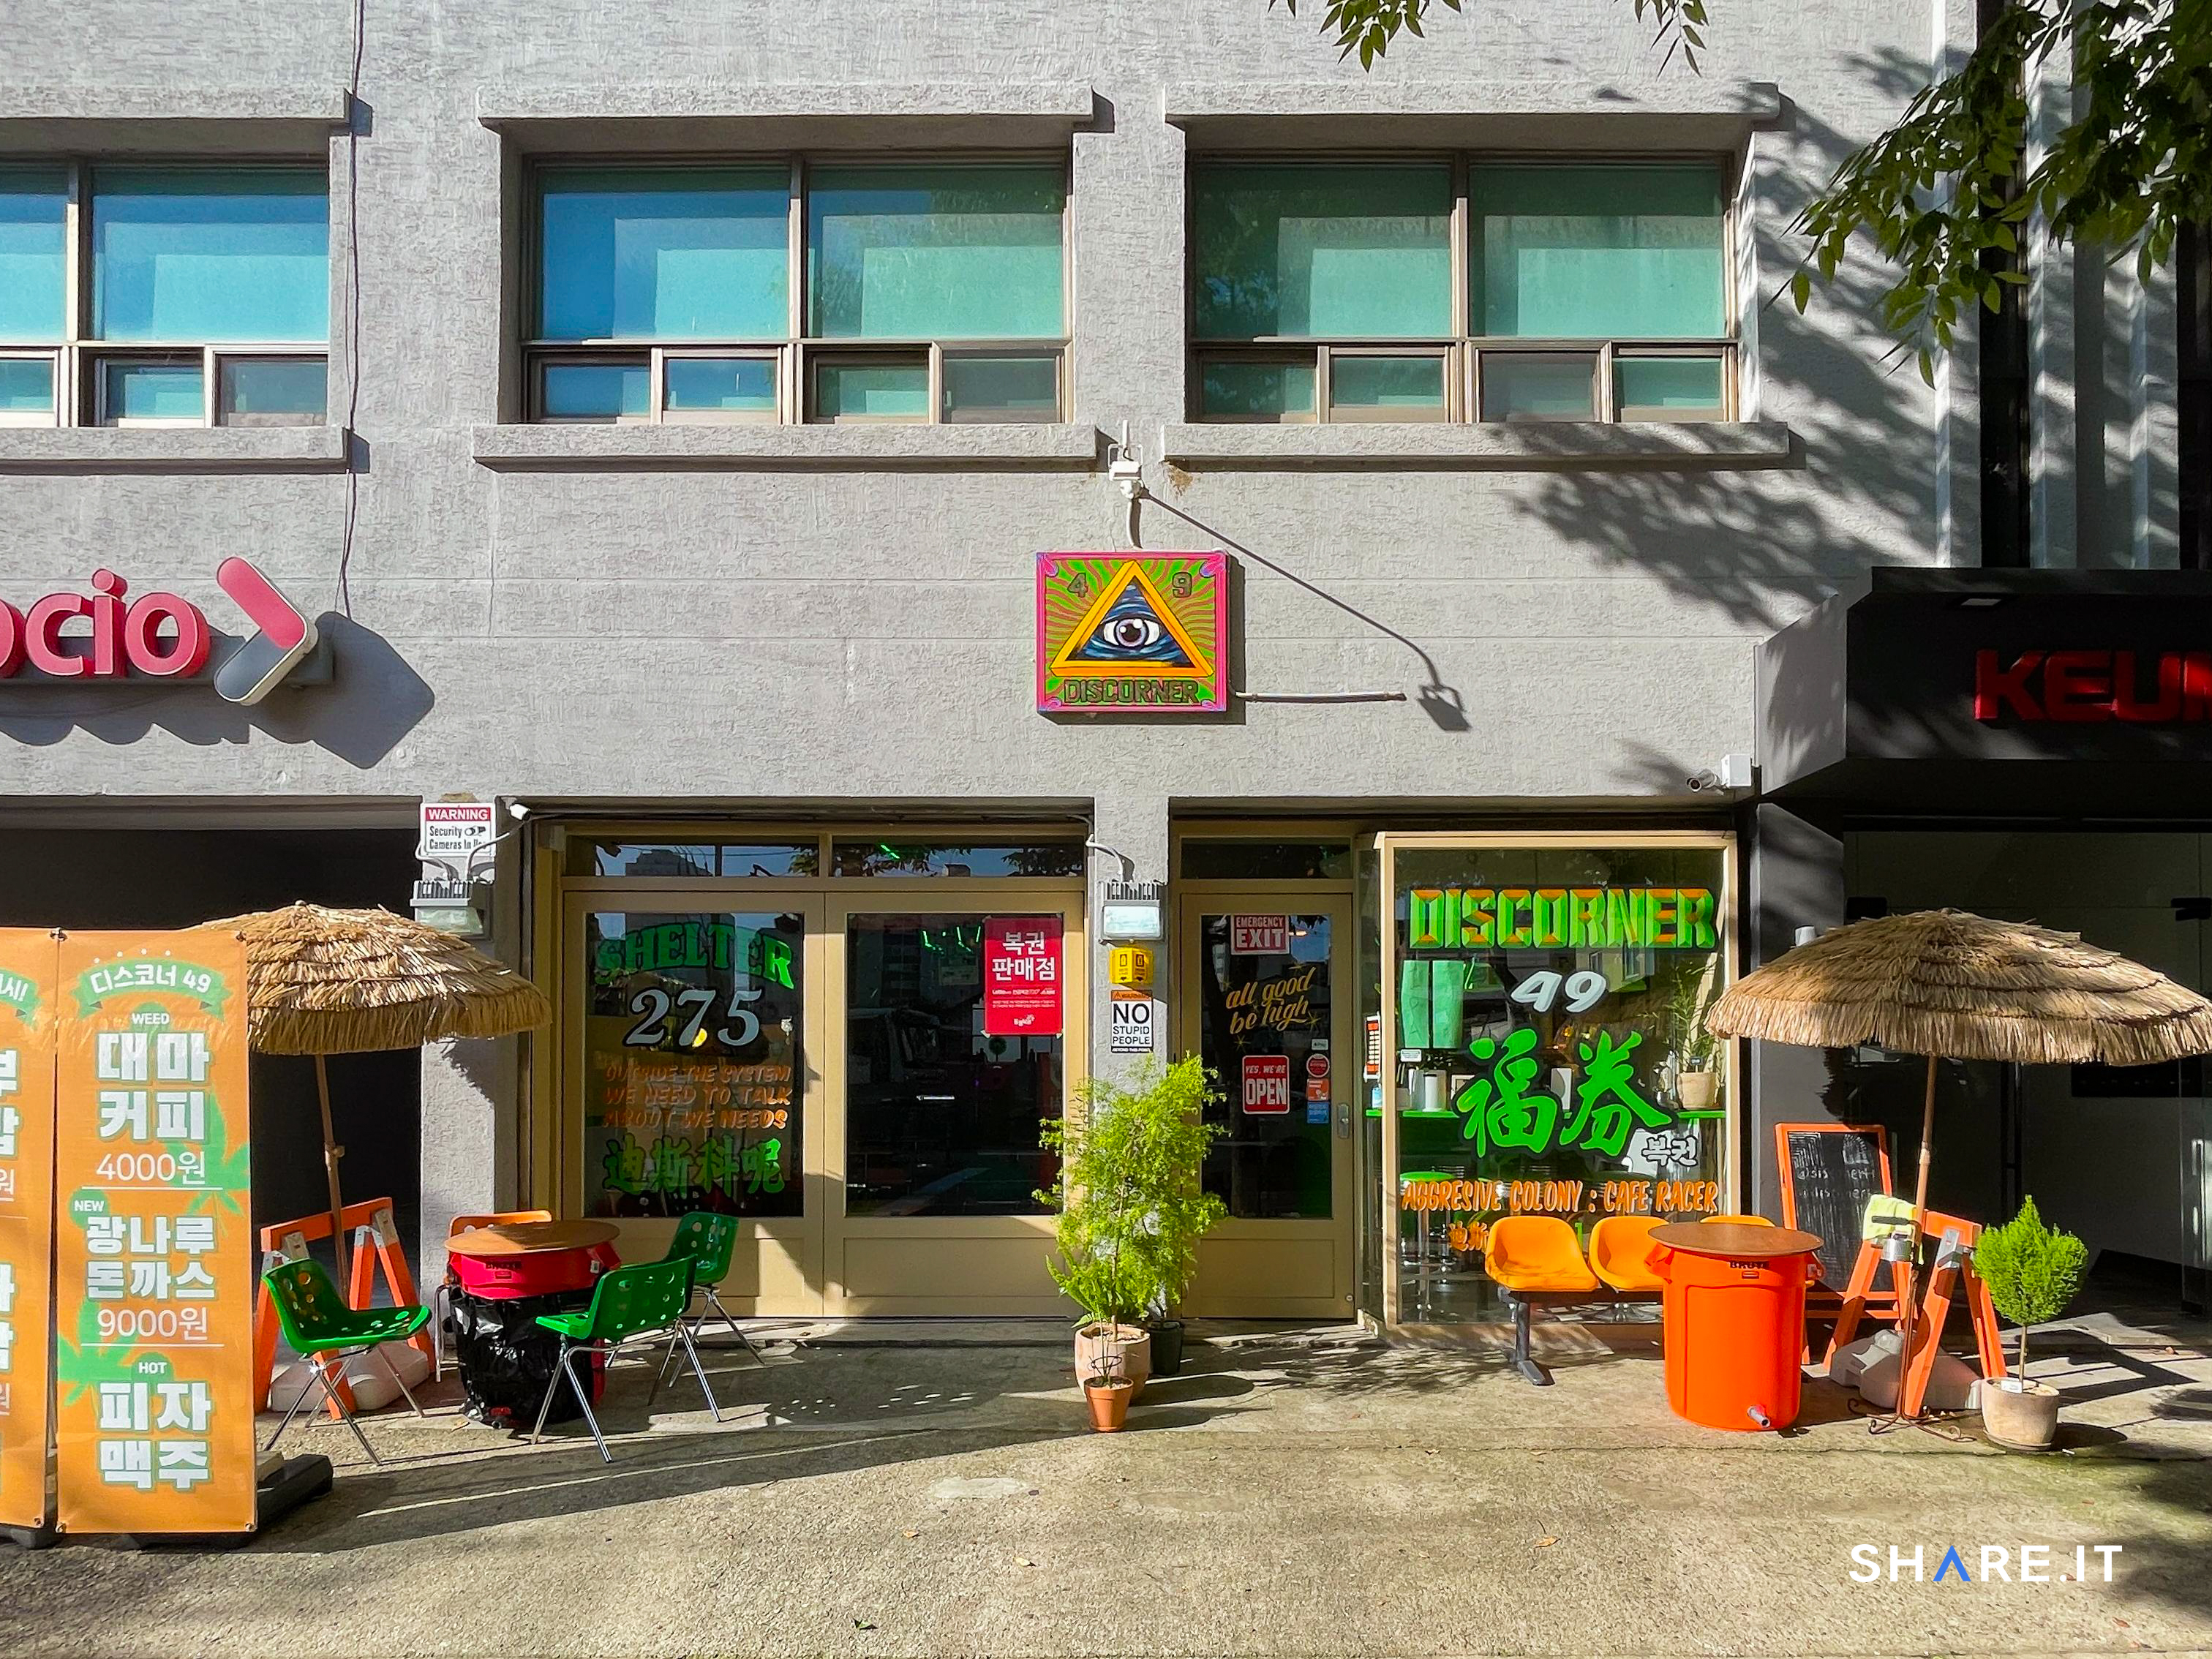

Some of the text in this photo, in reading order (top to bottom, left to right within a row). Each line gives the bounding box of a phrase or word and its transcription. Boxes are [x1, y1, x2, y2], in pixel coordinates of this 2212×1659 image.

[1067, 571, 1193, 598] 4 9
[0, 568, 205, 677] cio
[1064, 679, 1200, 704] DISCORNER
[428, 809, 488, 820] WARNING
[429, 825, 462, 838] Security
[429, 838, 462, 849] Cameras
[464, 839, 471, 849] In
[1235, 917, 1284, 927] EMERGENCY
[1409, 888, 1716, 949] DISCORNER
[1002, 931, 1045, 956] 복권
[1236, 928, 1284, 947] EXIT
[596, 922, 794, 990] SHELTER
[992, 957, 1055, 981] 판매점
[90, 964, 211, 993] 디스코너 49
[1226, 966, 1317, 1009] all good
[1511, 971, 1607, 1013] 49
[132, 1012, 170, 1025] WEED
[624, 988, 762, 1047] 275
[1113, 1003, 1150, 1024] NO
[1230, 995, 1309, 1034] be high
[1112, 1036, 1151, 1045] PEOPLE
[1113, 1026, 1150, 1035] STUPID
[98, 1033, 209, 1081] 대마
[1245, 1065, 1287, 1075] YES, WE'RE
[606, 1065, 791, 1083] OUTSIDE THE SYSTEM
[604, 1086, 793, 1106] WE NEED TO TALK
[1245, 1077, 1287, 1105] OPEN
[1457, 1028, 1672, 1158] 福券
[99, 1091, 206, 1140] 커피
[603, 1108, 789, 1129] ABOUT WE NEEDS
[96, 1151, 206, 1185] 4000원
[603, 1132, 786, 1200] 迪斯科呢
[75, 1200, 105, 1211] NEW
[1402, 1180, 1720, 1213] AGGRESIVE COLONY : CAFE RACER
[87, 1216, 215, 1254] 광나루
[87, 1261, 215, 1299] 돈까스
[97, 1306, 208, 1341] 9000원
[138, 1361, 167, 1374] HOT
[99, 1382, 211, 1431] 피자
[99, 1440, 209, 1489] 맥주
